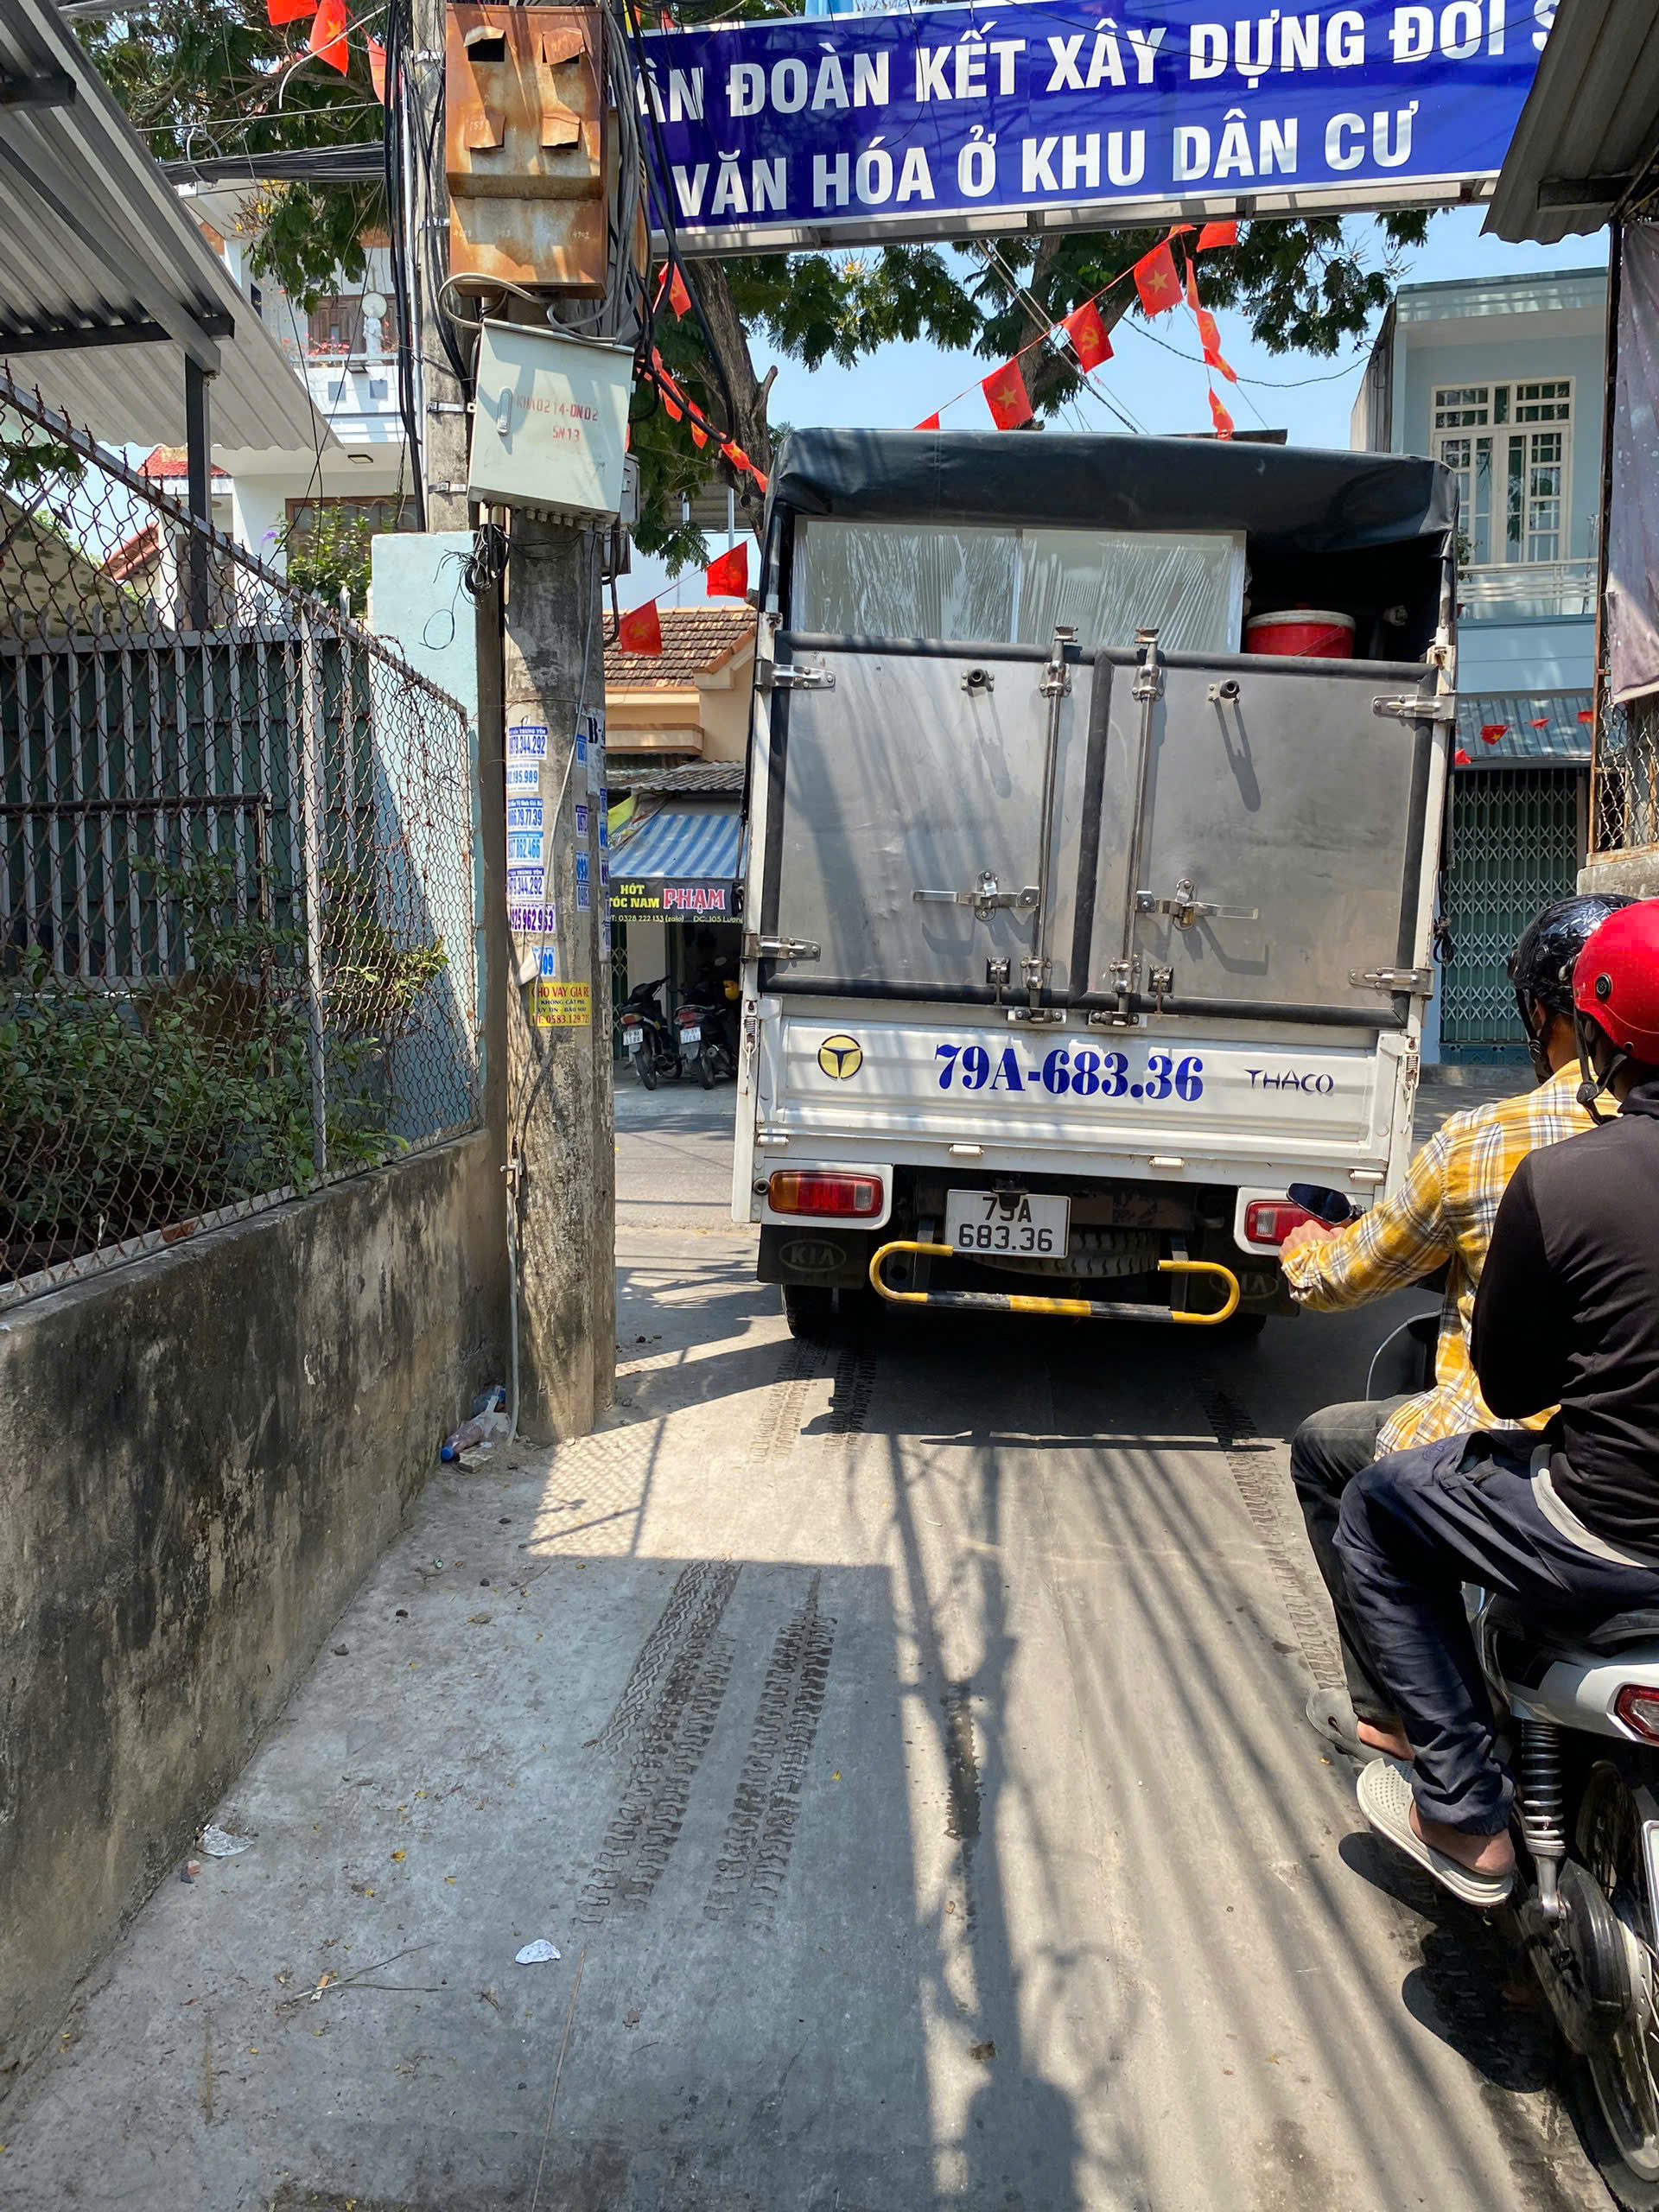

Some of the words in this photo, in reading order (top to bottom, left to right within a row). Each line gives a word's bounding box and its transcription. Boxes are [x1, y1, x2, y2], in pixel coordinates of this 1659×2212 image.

[608, 57, 704, 123] ÂN
[725, 42, 889, 118] ĐOÀN
[915, 21, 1026, 102] KẾT
[1046, 17, 1167, 92] XÂY
[1189, 9, 1366, 89] DỰNG
[671, 149, 787, 217] VĂN
[812, 136, 936, 207] HÓA
[957, 125, 997, 197] Ở
[1021, 129, 1146, 193] KHU
[1172, 108, 1299, 181] DÂN
[1324, 100, 1420, 171] CƯ
[630, 897, 660, 908] NAM
[663, 888, 727, 914] PHẠM
[551, 987, 569, 997] VAY
[934, 1043, 1204, 1102] 79A-683.36
[1243, 1068, 1334, 1095] THACO
[958, 1223, 1053, 1252] 683.36
[791, 1245, 835, 1266] KIA
